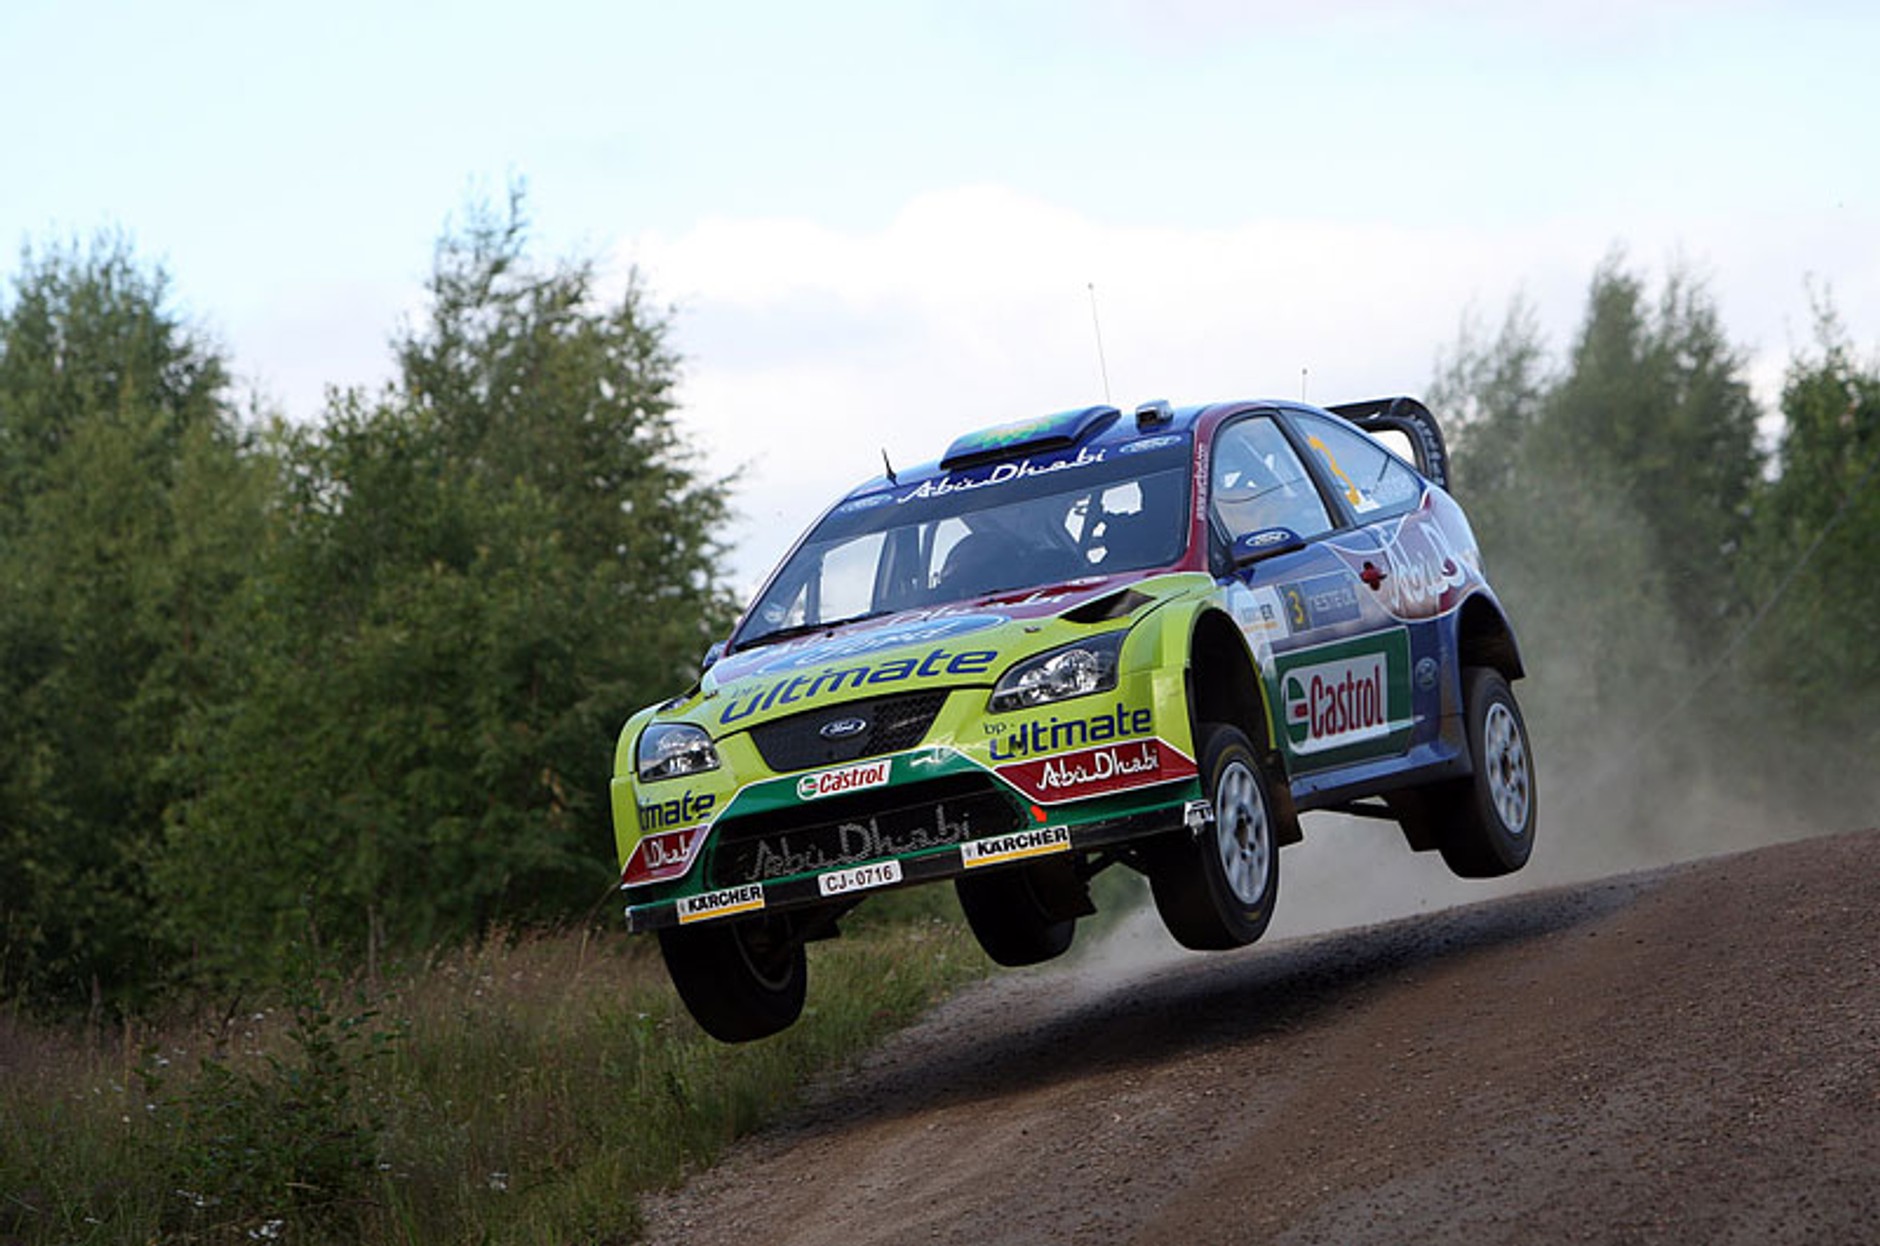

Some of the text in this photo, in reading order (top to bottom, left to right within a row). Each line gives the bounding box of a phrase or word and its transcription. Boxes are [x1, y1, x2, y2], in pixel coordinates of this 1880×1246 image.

[897, 476, 988, 504] Abu
[988, 448, 1106, 486] Dhabi
[1288, 590, 1305, 625] 3
[720, 649, 998, 725] ultimate
[1310, 664, 1384, 738] Castrol
[990, 702, 1152, 760] ultimate
[819, 764, 884, 794] Castrol
[1036, 743, 1159, 790] Abu Dhabi
[838, 804, 970, 862] Dhabi
[826, 865, 894, 892] CJ-0716
